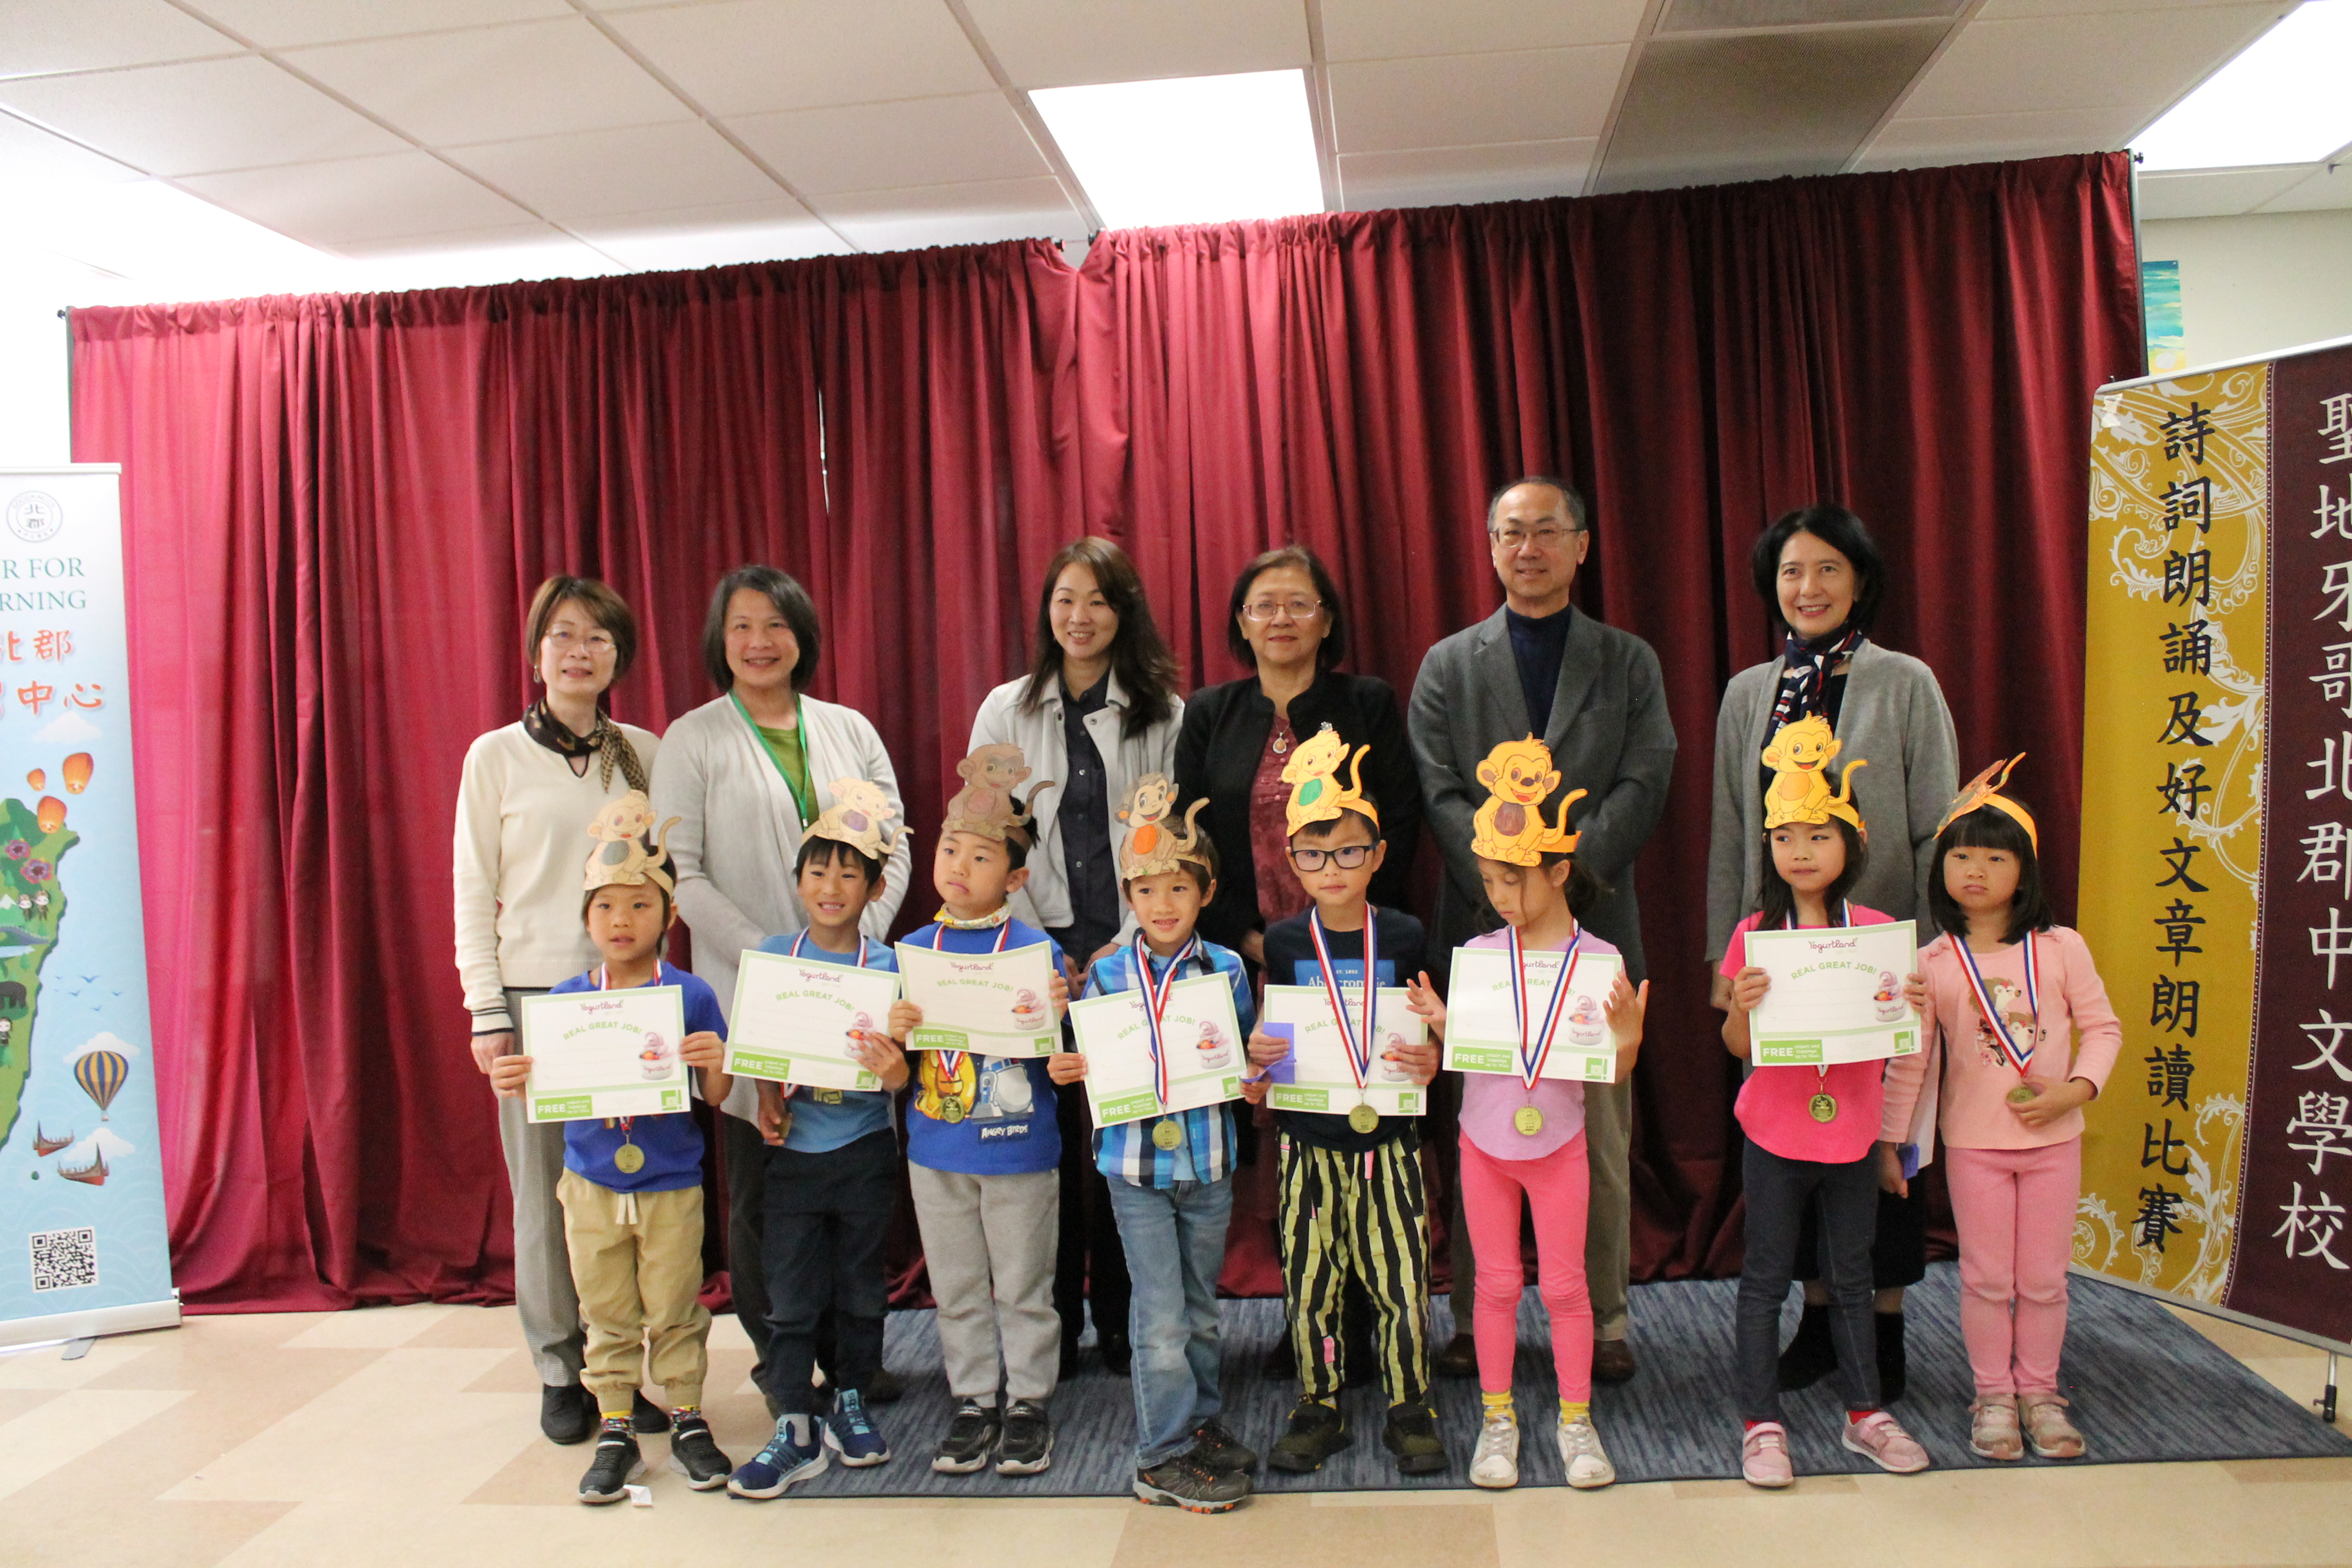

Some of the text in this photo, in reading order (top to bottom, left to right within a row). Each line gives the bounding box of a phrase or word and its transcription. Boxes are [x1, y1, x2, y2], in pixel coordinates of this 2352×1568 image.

[28, 557, 85, 578] FOR
[0, 680, 102, 715] 中心
[2130, 401, 2215, 1253] 詩詞朗誦及好文章朗讀比賽
[1808, 937, 1858, 954] Yogurtland
[950, 961, 994, 972] Yogurtland
[1790, 961, 1877, 980] REAL GREAT JOB!
[799, 968, 843, 982] Yogurtland
[937, 979, 1014, 992] REAL GREAT JOB!
[1492, 981, 1513, 991] REA
[1527, 978, 1551, 987] REAT
[580, 999, 625, 1015] Yogurtland
[776, 990, 855, 1012] REAL GREAT JOB!
[563, 1021, 643, 1040] REAL GREAT JOB!
[1117, 1015, 1196, 1040] REAL GAT JOB!
[1305, 1020, 1329, 1033] REAL
[1455, 1053, 1485, 1064] FREE
[1763, 1047, 1793, 1057] FREE
[734, 1058, 763, 1070] FREE
[1276, 1093, 1303, 1103] FREE
[537, 1103, 566, 1114] FREE
[1102, 1104, 1131, 1118] FREE
